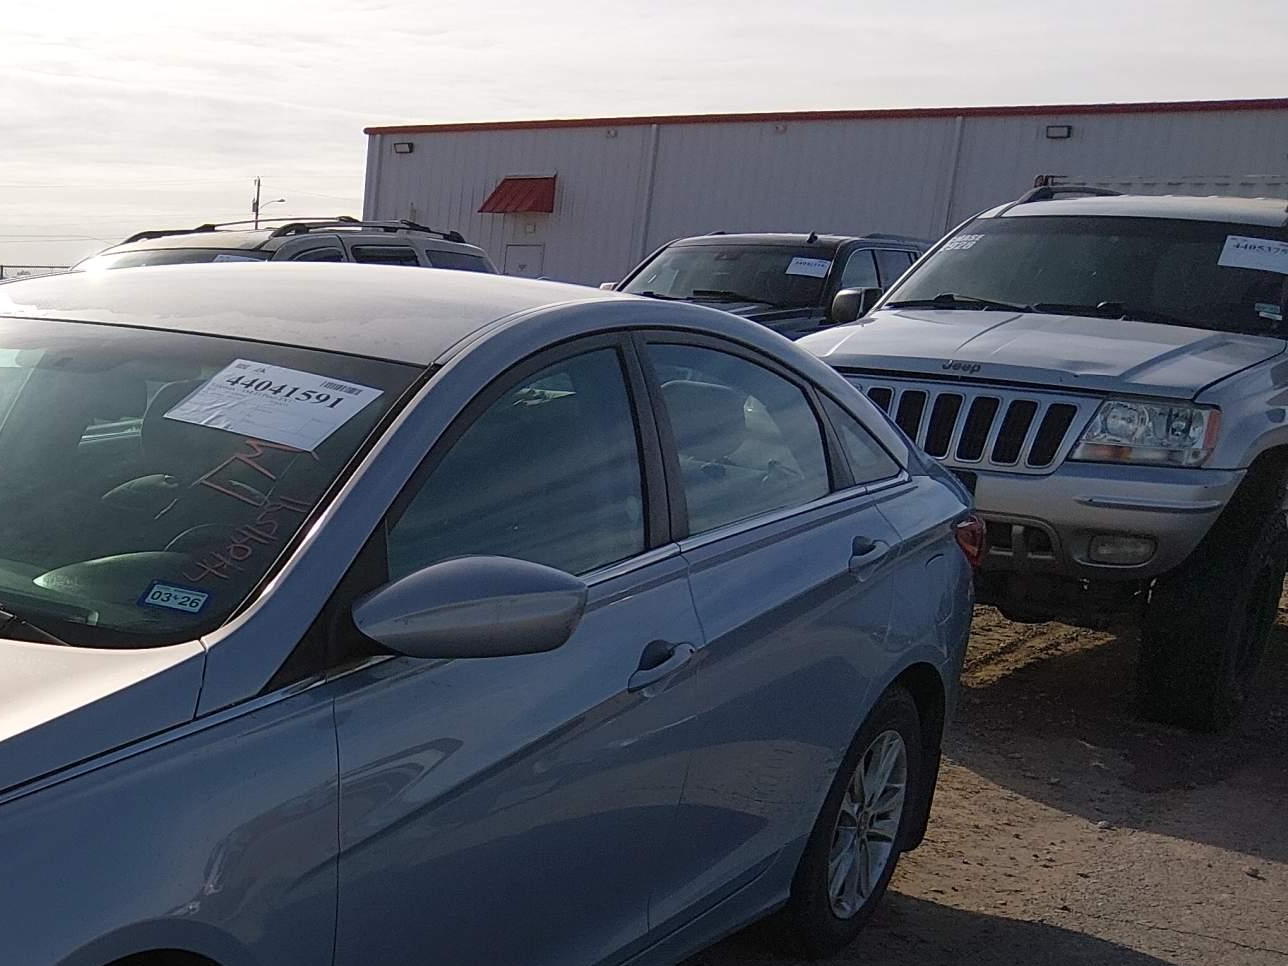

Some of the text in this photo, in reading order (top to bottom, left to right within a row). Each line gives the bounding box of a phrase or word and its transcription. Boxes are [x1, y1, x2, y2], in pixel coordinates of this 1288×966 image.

[942, 359, 981, 375] Jeep
[226, 375, 345, 409] 44041591
[151, 590, 172, 602] 03
[178, 596, 201, 608] 26
